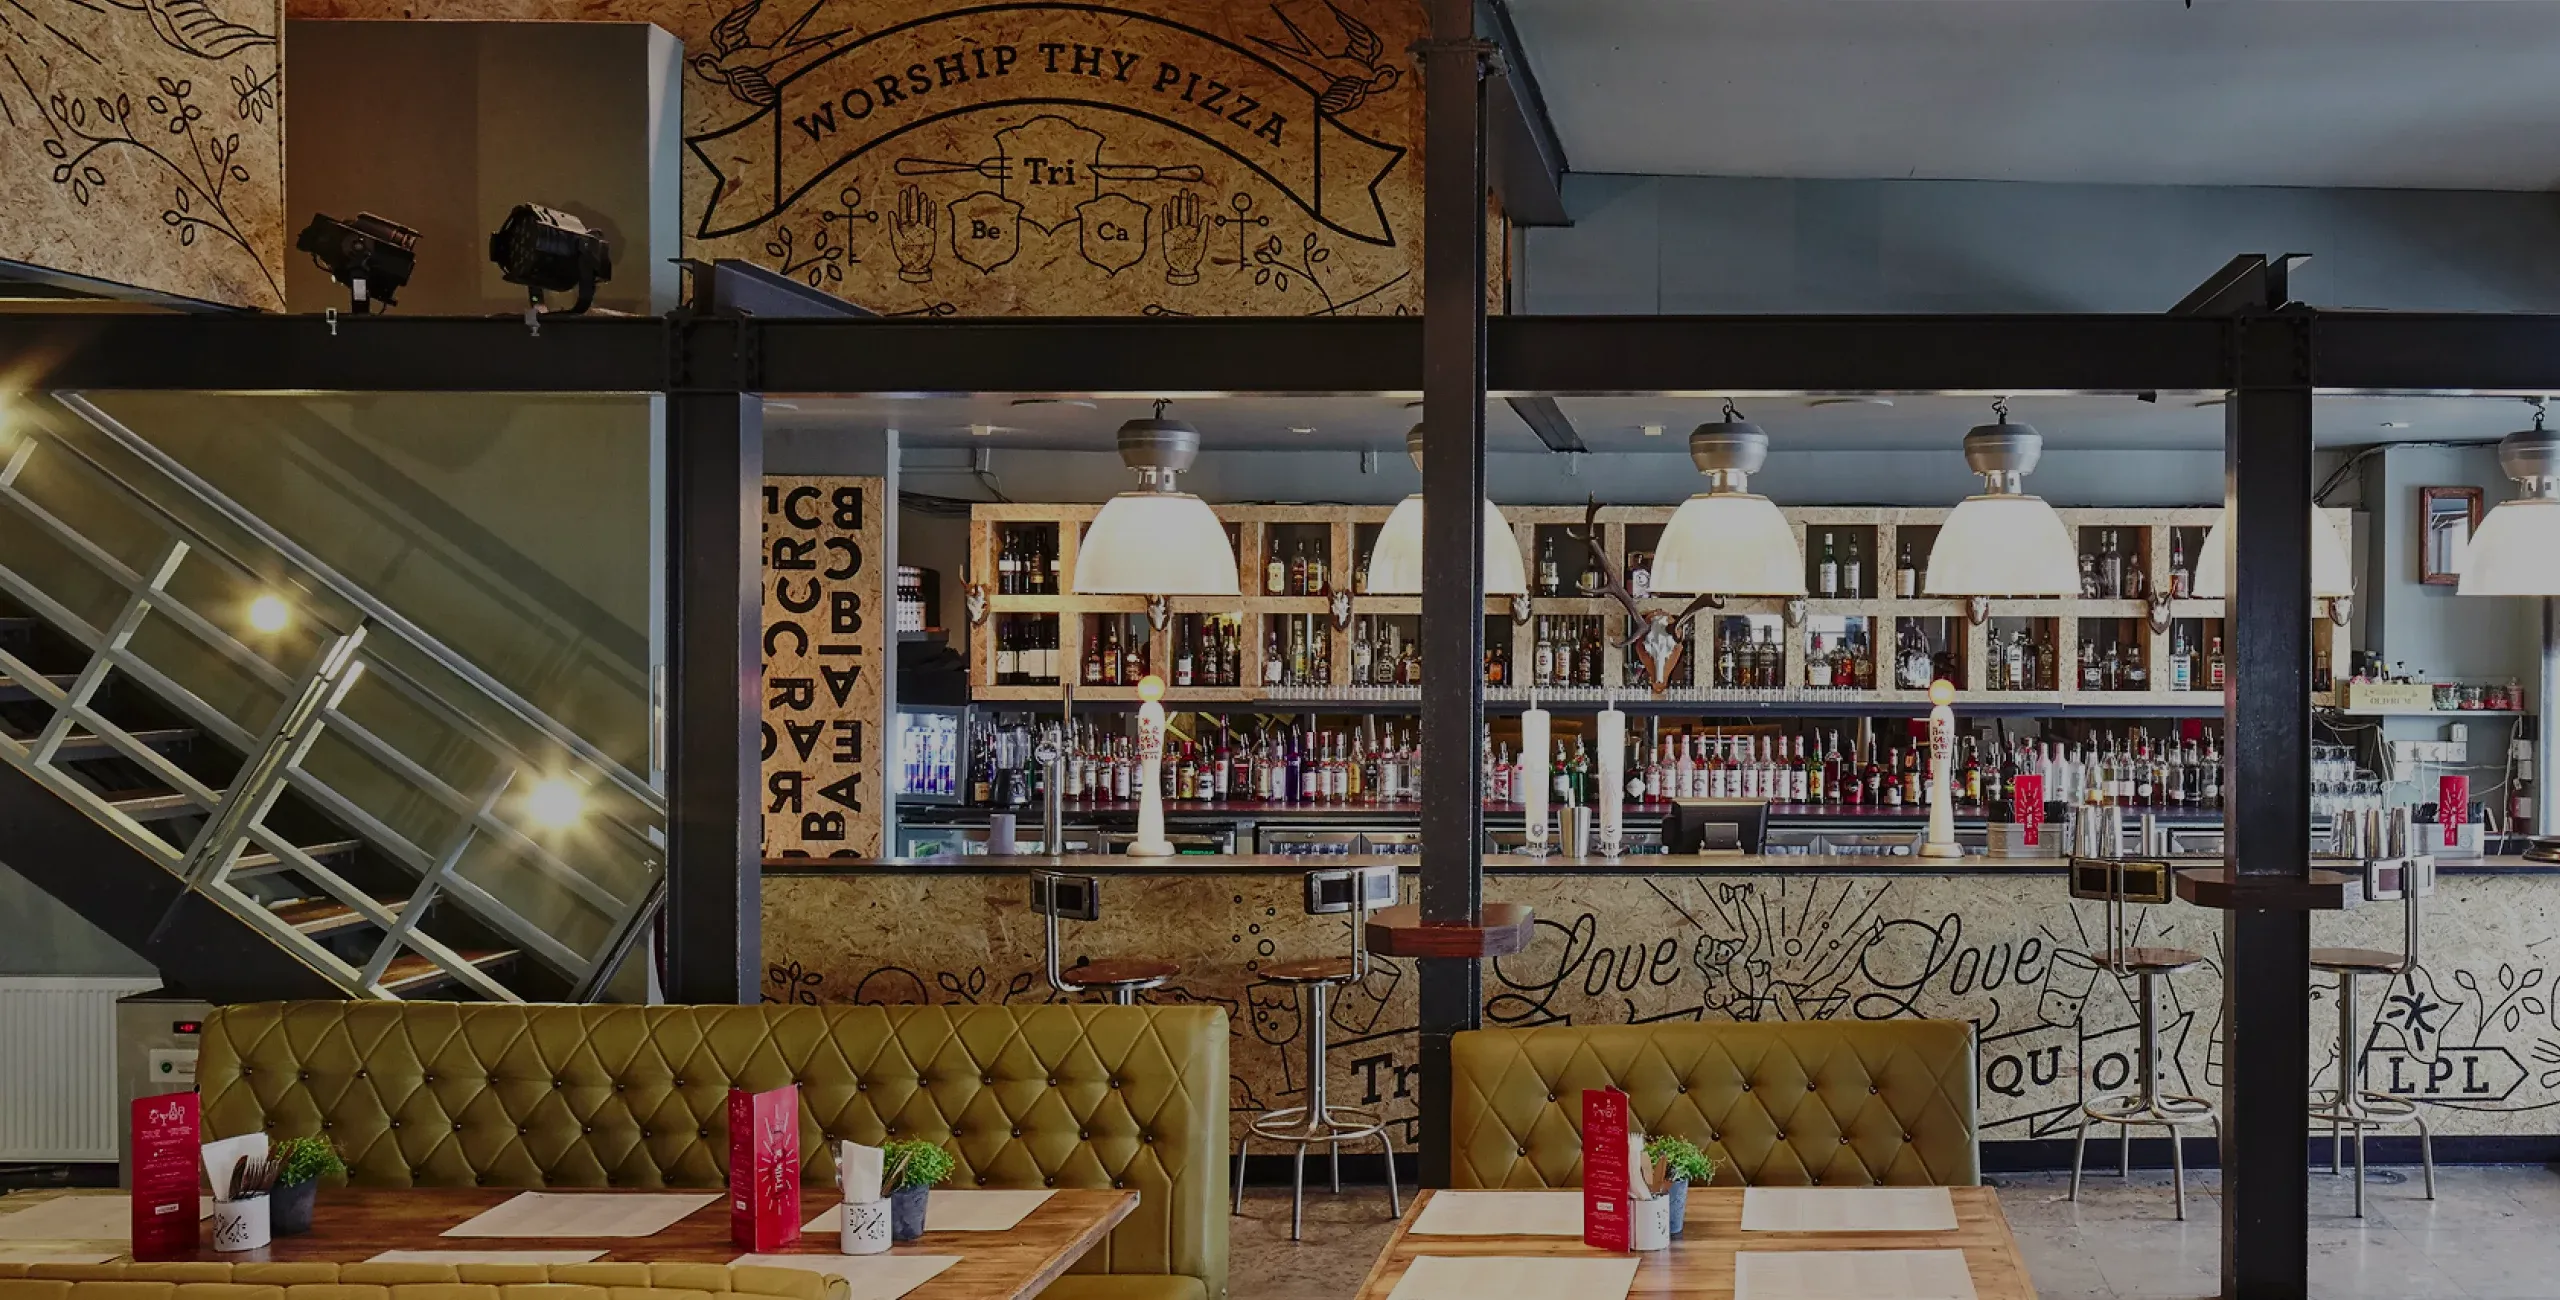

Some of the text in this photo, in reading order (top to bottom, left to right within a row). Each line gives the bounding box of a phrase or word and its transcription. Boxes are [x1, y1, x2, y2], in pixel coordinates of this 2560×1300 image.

[793, 42, 1288, 148] WORSHIP THY PIZZA
[1023, 157, 1077, 186] Tri
[971, 219, 1001, 240] Be
[1096, 221, 1130, 241] Ca
[1487, 912, 1681, 1023] Love
[1854, 912, 2046, 1020] Love
[1986, 1045, 2061, 1097] QU
[2389, 1056, 2490, 1093] LPL
